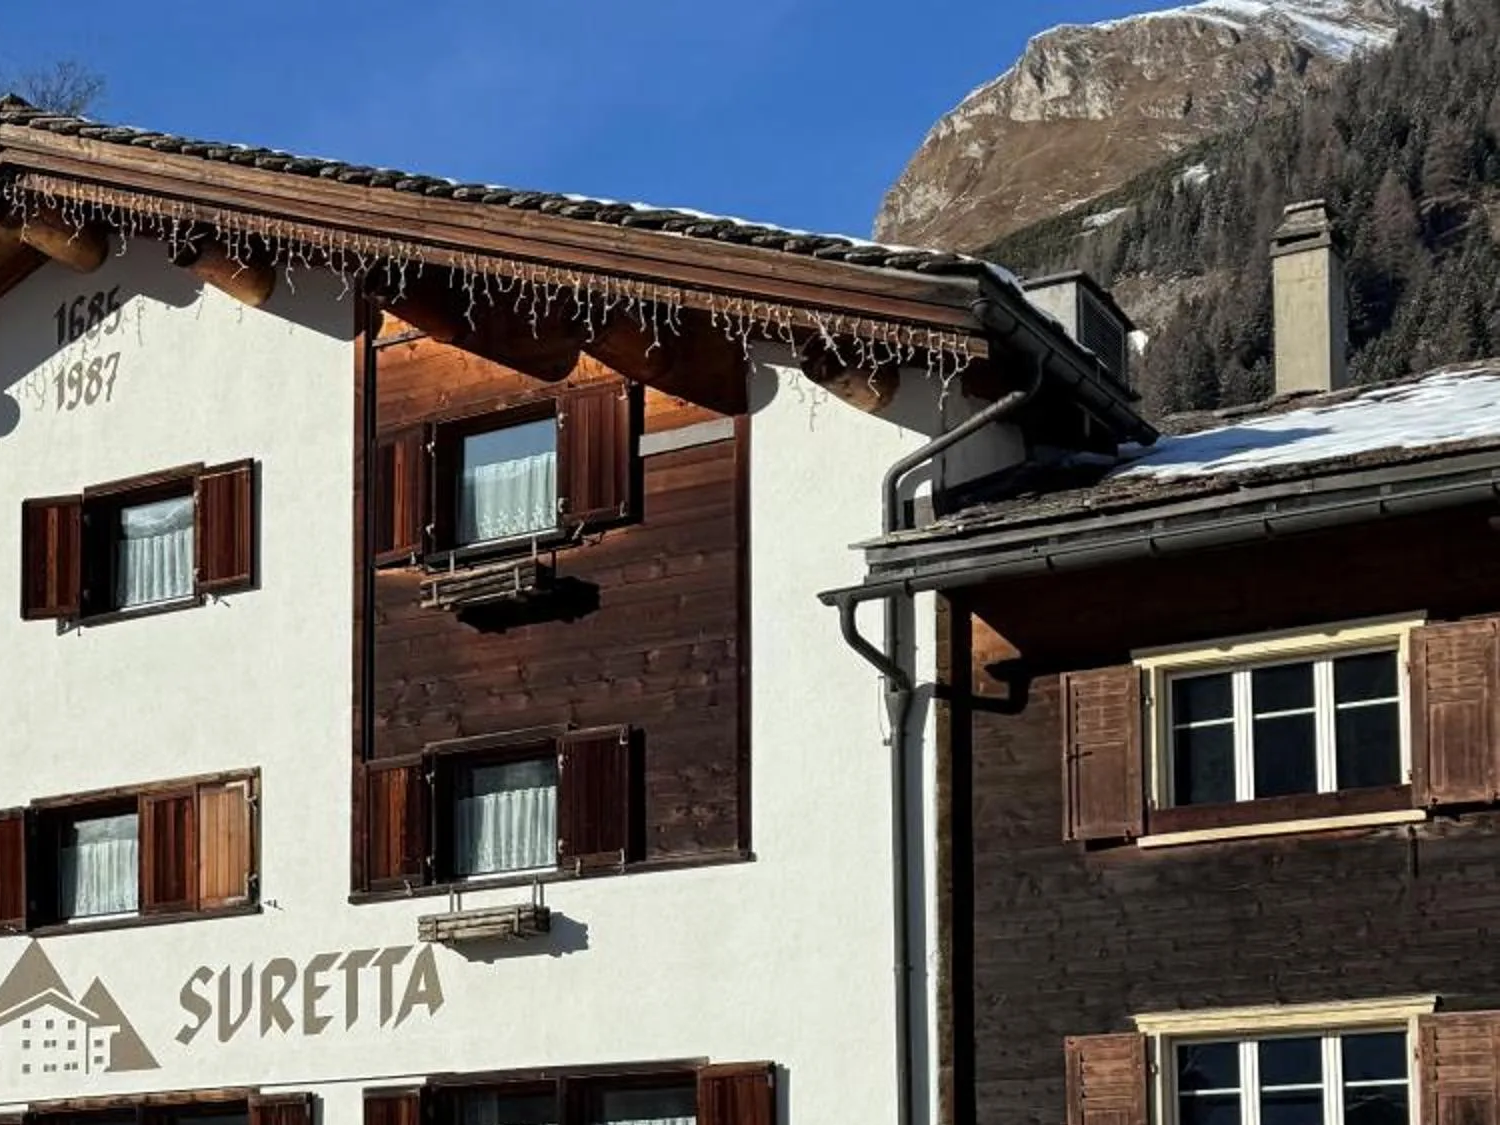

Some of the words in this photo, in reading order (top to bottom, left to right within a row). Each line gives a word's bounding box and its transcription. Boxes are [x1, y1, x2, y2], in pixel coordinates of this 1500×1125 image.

[53, 284, 122, 346] 1685
[52, 351, 121, 411] 1987
[175, 943, 445, 1046] SURETTA
